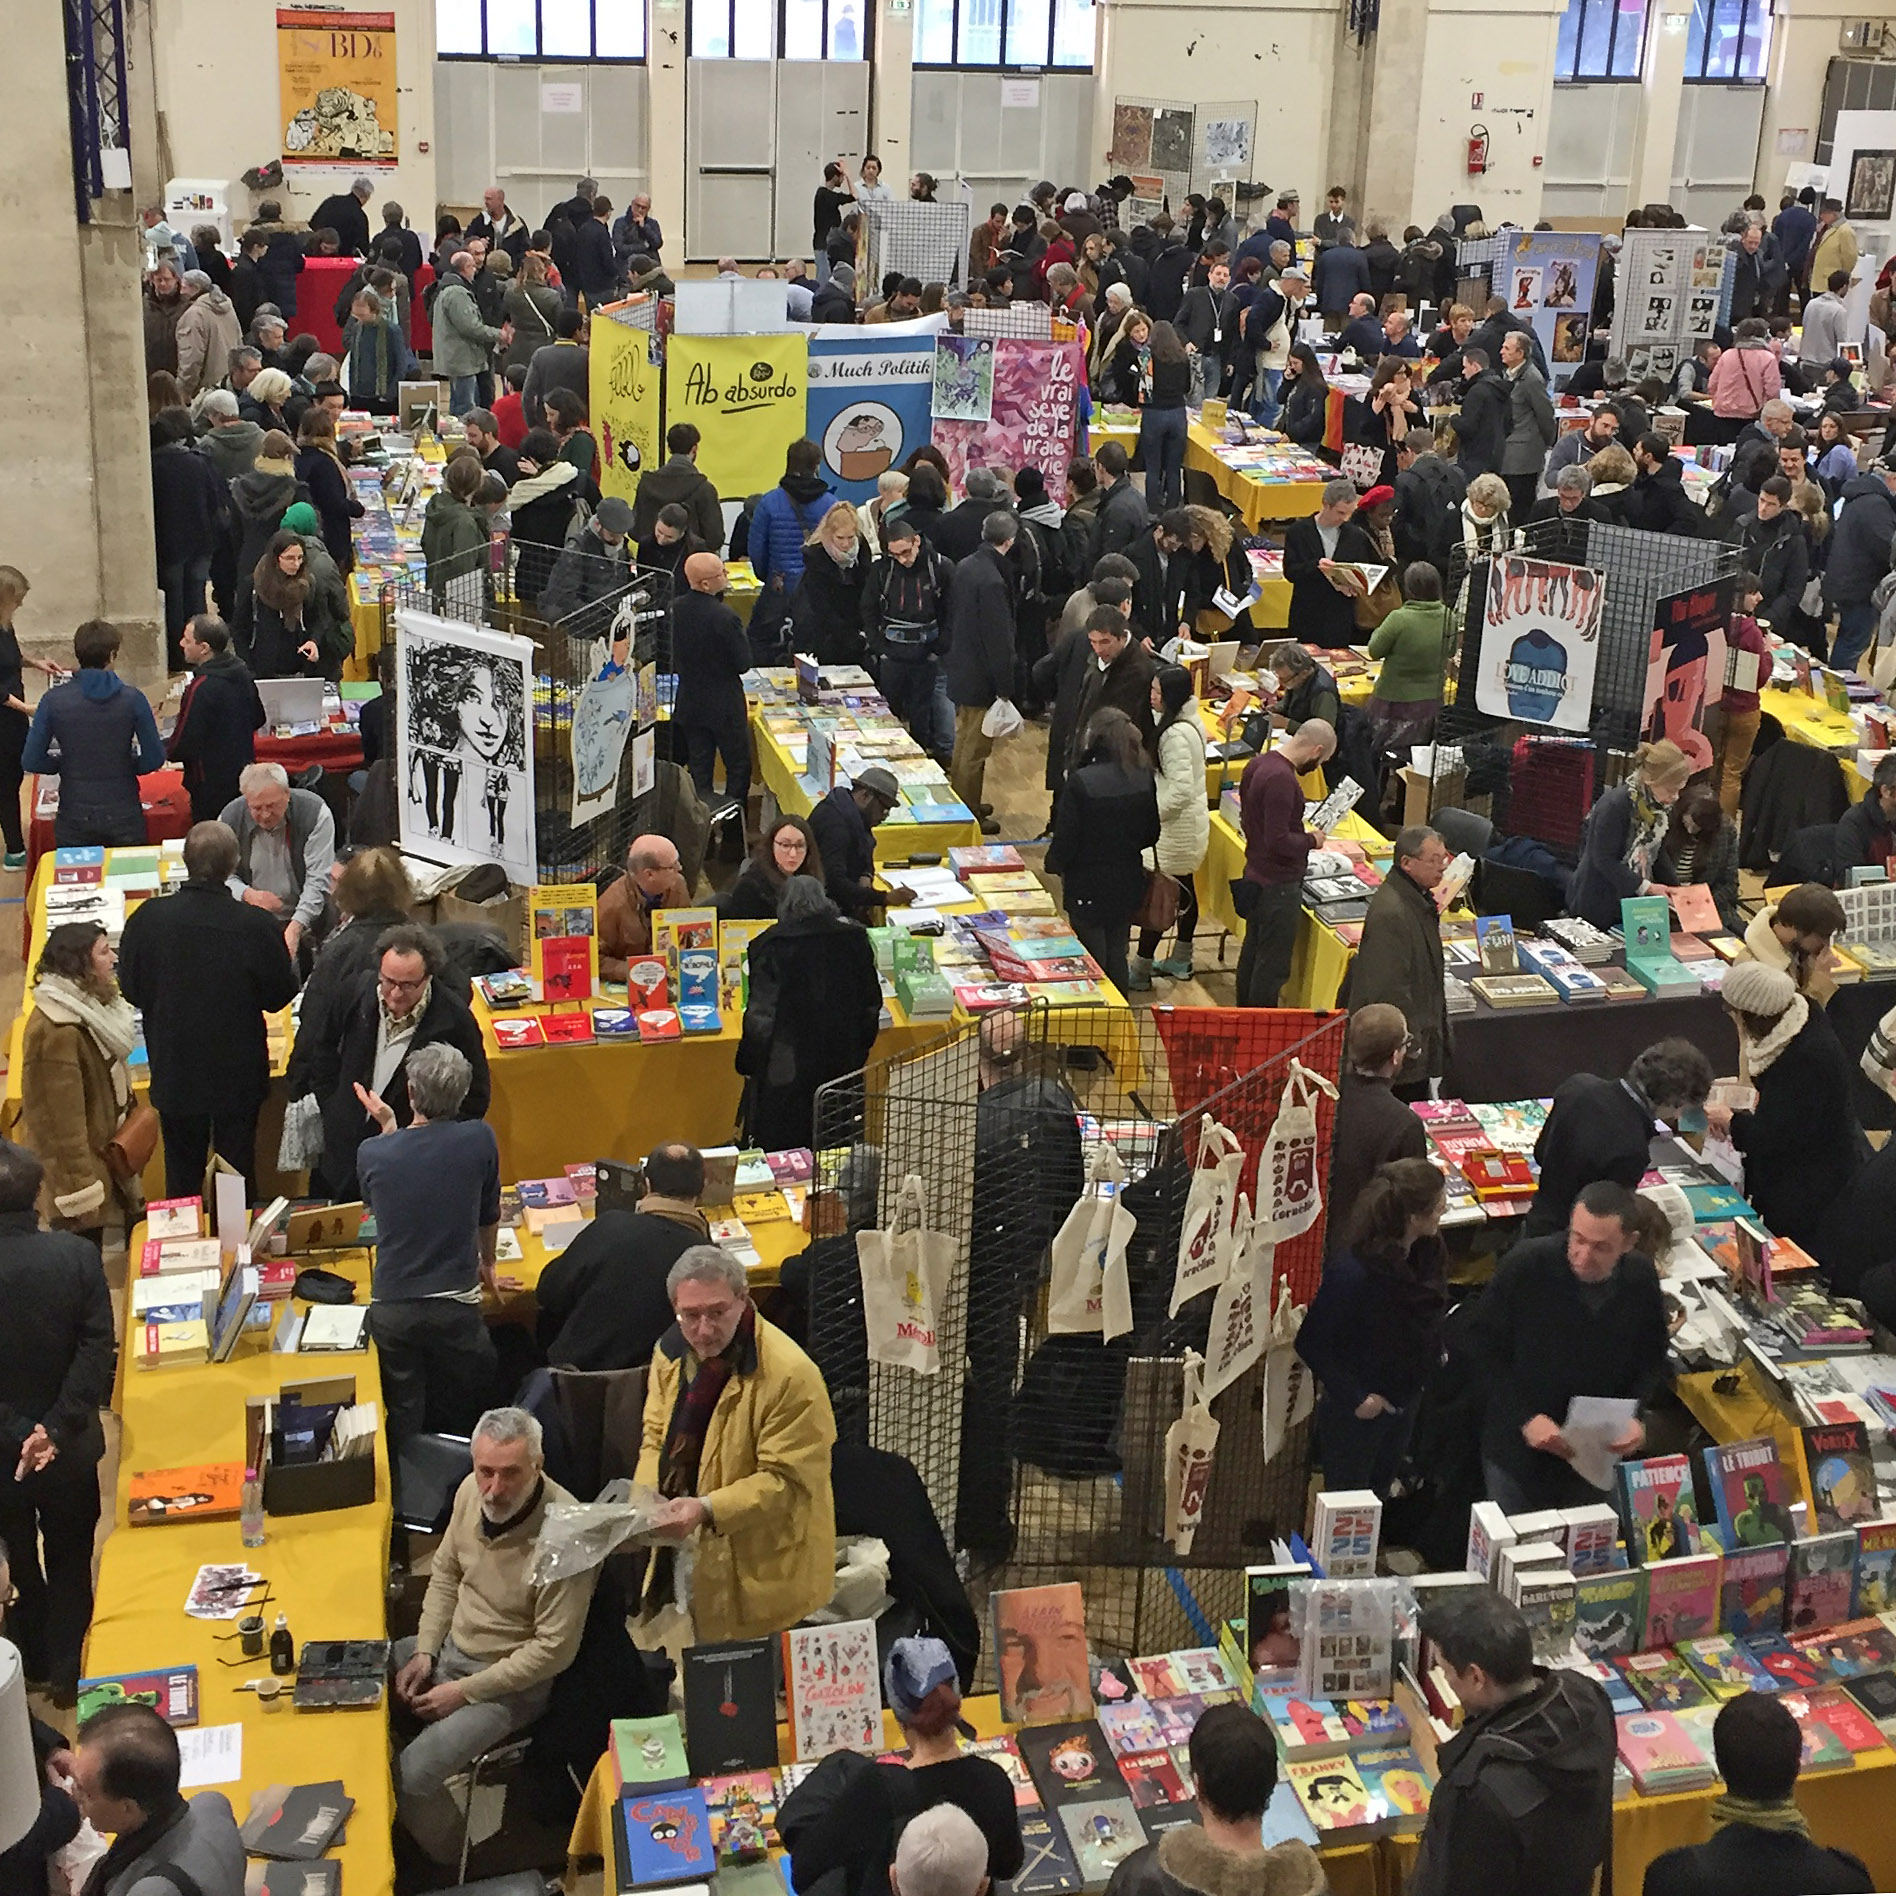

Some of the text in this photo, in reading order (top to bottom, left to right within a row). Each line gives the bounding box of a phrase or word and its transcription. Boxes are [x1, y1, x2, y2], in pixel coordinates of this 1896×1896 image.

[824, 359, 931, 379] Much Politik
[1051, 350, 1074, 383] le
[685, 362, 797, 405] Ab absurdo
[1041, 383, 1072, 401] vrai
[1029, 400, 1070, 421] sexe
[1026, 418, 1070, 439] de la
[1022, 438, 1066, 457] vraie
[1038, 458, 1063, 475] vie
[1495, 662, 1531, 684] LOVE
[1722, 1456, 1736, 1473] LE
[1631, 1464, 1690, 1488] PATIENCE
[1291, 1759, 1347, 1777] FRANKY
